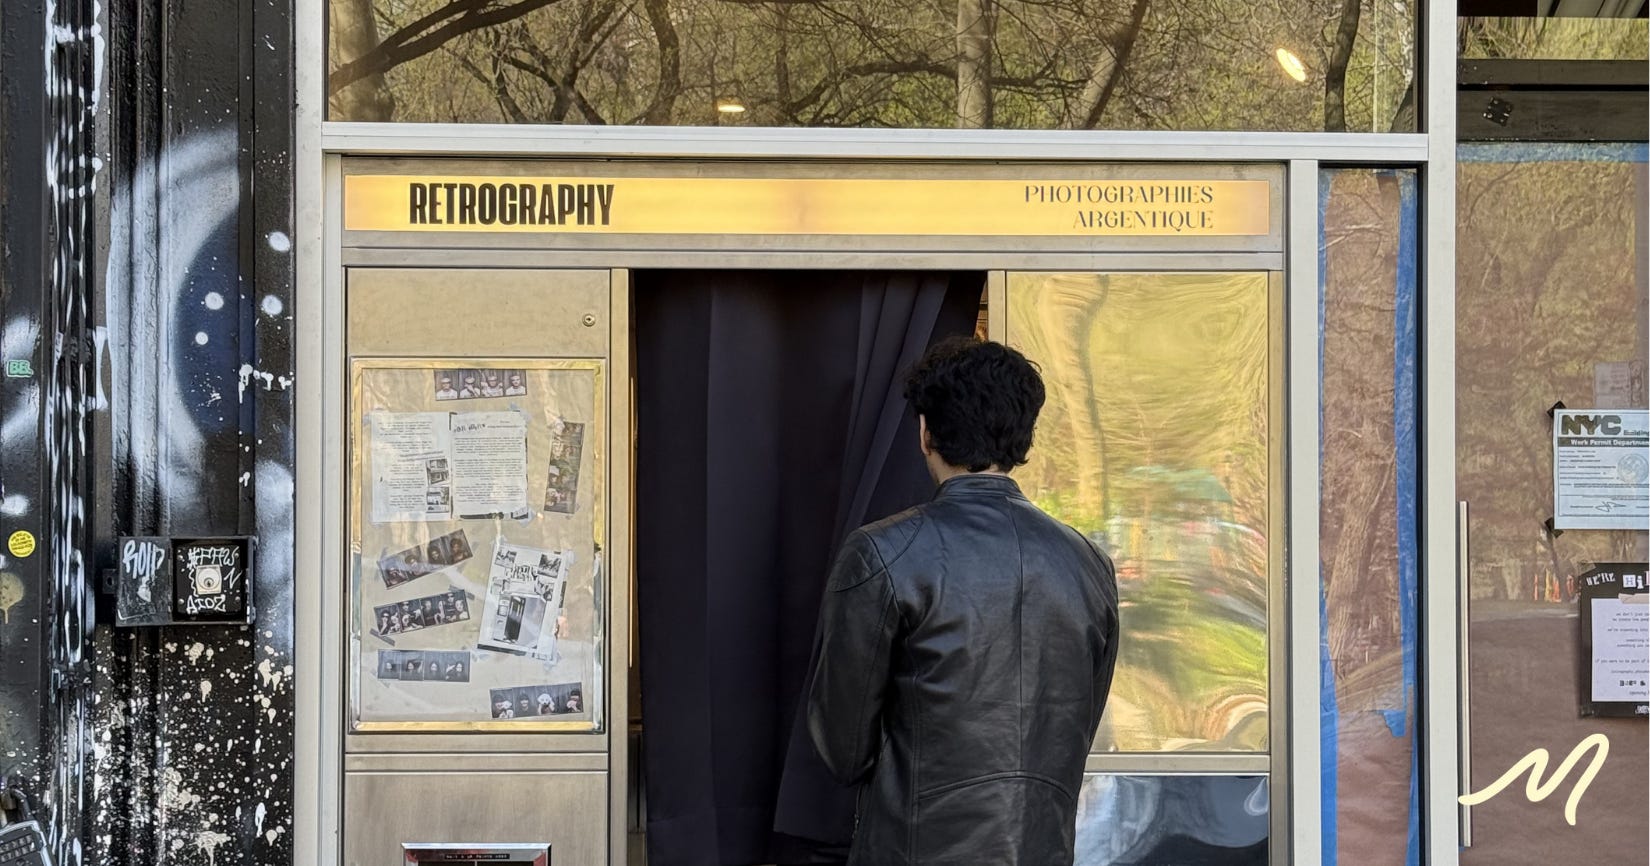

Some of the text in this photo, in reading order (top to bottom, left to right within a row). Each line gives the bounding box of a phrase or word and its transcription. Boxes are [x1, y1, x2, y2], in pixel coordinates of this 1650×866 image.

[410, 183, 614, 225] RETROGRAPHY
[1025, 185, 1213, 204] PHOTOGRAPHIES
[1073, 210, 1213, 231] ARGENTIQUE
[1562, 415, 1622, 435] NYC
